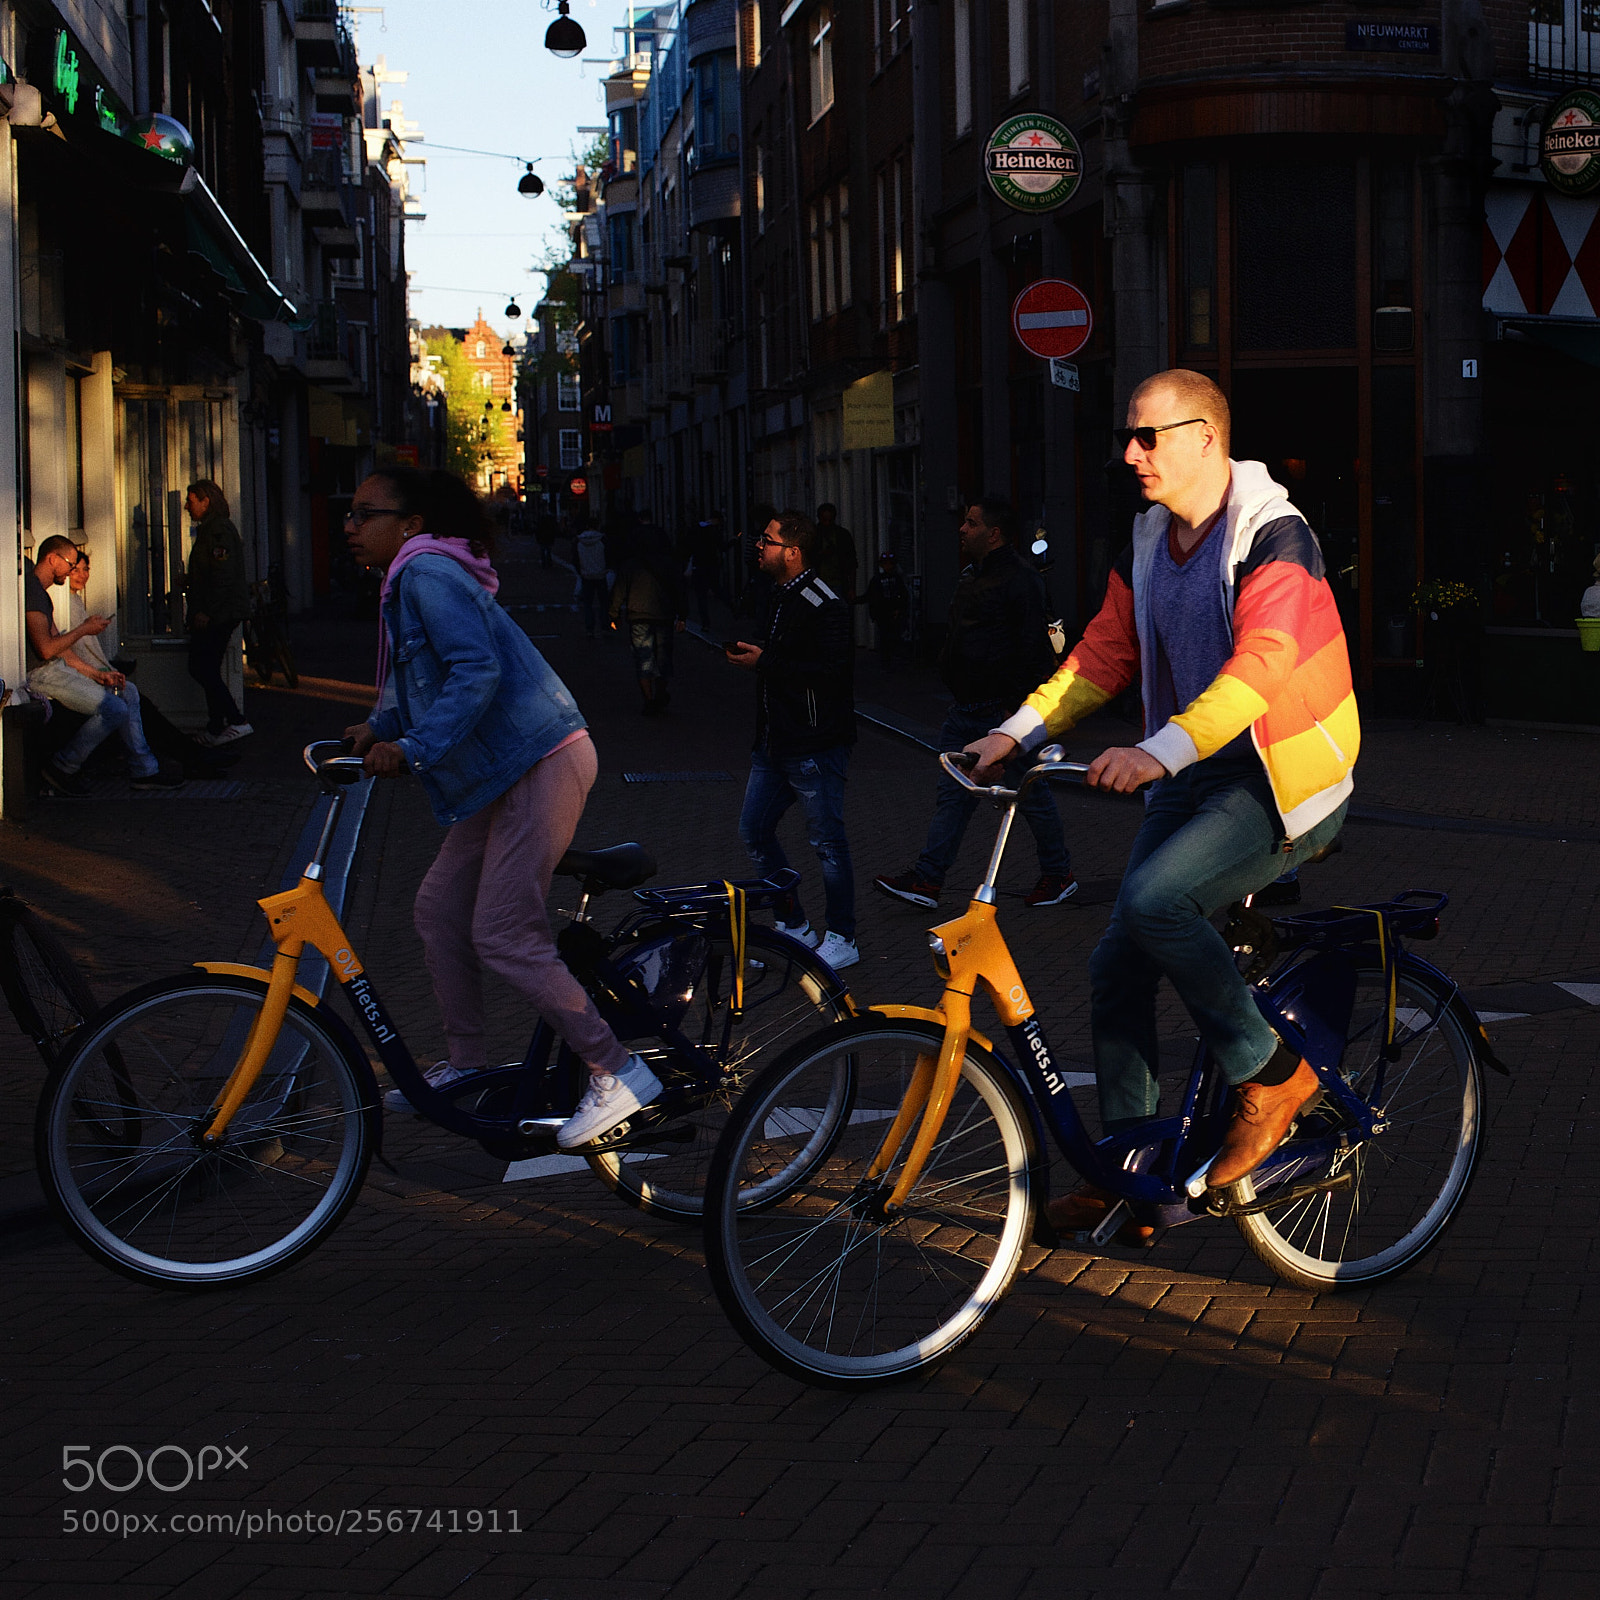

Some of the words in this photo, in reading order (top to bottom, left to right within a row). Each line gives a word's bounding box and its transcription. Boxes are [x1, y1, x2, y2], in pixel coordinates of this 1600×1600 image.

[1357, 24, 1430, 39] NIEUWMARKT
[1398, 40, 1430, 49] CENTRUM
[1001, 119, 1035, 141] HEINEKEN
[1036, 119, 1069, 142] PILSENER
[994, 152, 1075, 170] Heineken
[1000, 180, 1037, 204] PREMIUM
[1039, 181, 1070, 204] QUALITY
[1466, 361, 1473, 376] 1
[594, 404, 612, 422] M
[335, 948, 397, 1044] OV-fiets.nl
[1009, 984, 1066, 1096] OV-fiets.nl
